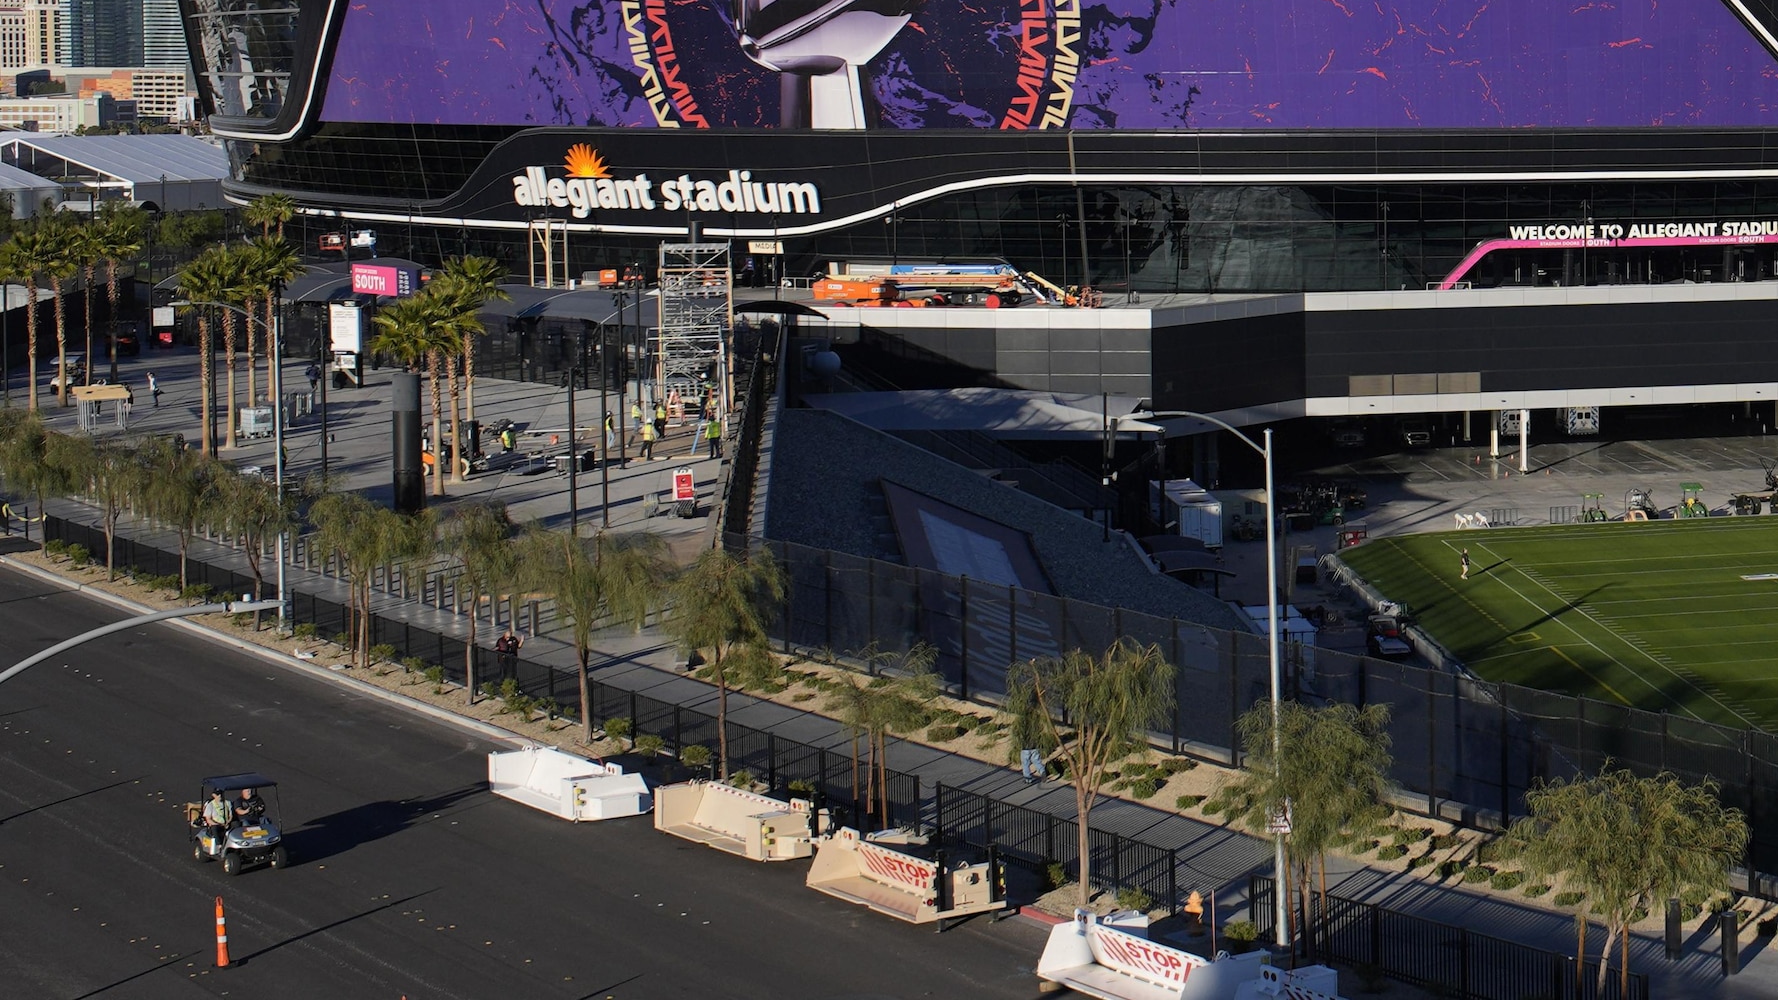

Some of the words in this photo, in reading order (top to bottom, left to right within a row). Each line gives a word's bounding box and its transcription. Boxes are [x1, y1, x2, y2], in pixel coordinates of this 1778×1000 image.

[512, 166, 656, 218] allegiant
[661, 169, 821, 214] stadium
[1510, 224, 1595, 240] WELCOME
[1600, 224, 1624, 238] TO
[1628, 222, 1718, 238] ALLEGIANT
[354, 274, 386, 291] SOUTH
[884, 856, 930, 879] STOP
[1126, 941, 1182, 970] STOP
